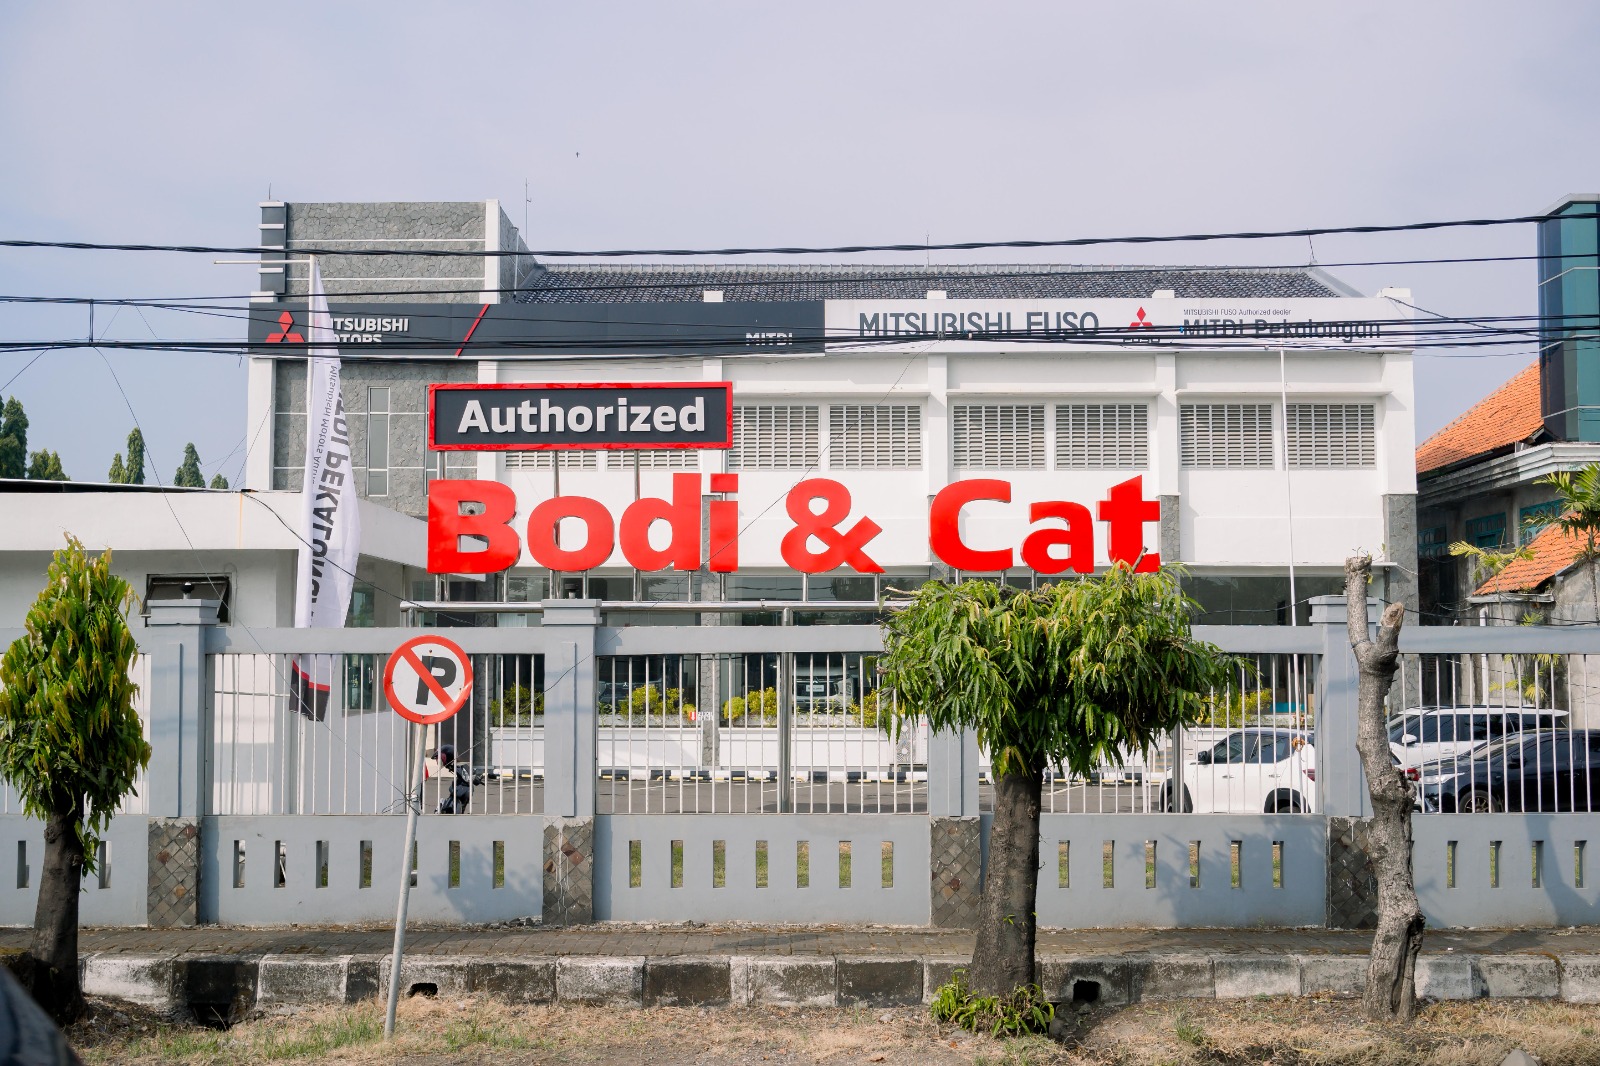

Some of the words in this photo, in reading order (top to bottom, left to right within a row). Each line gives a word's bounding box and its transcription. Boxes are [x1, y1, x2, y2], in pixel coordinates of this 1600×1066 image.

[331, 317, 409, 331] ITSUBISHI
[859, 311, 1012, 336] MITSUBISHI
[1026, 311, 1100, 337] FUSO
[1183, 308, 1219, 316] MITSUBISHI
[1238, 308, 1271, 316] Authorized
[1272, 308, 1292, 316] dealer
[457, 396, 705, 433] Authorized
[427, 473, 739, 574] Bodi
[780, 478, 886, 574] &
[928, 474, 1161, 575] Cat
